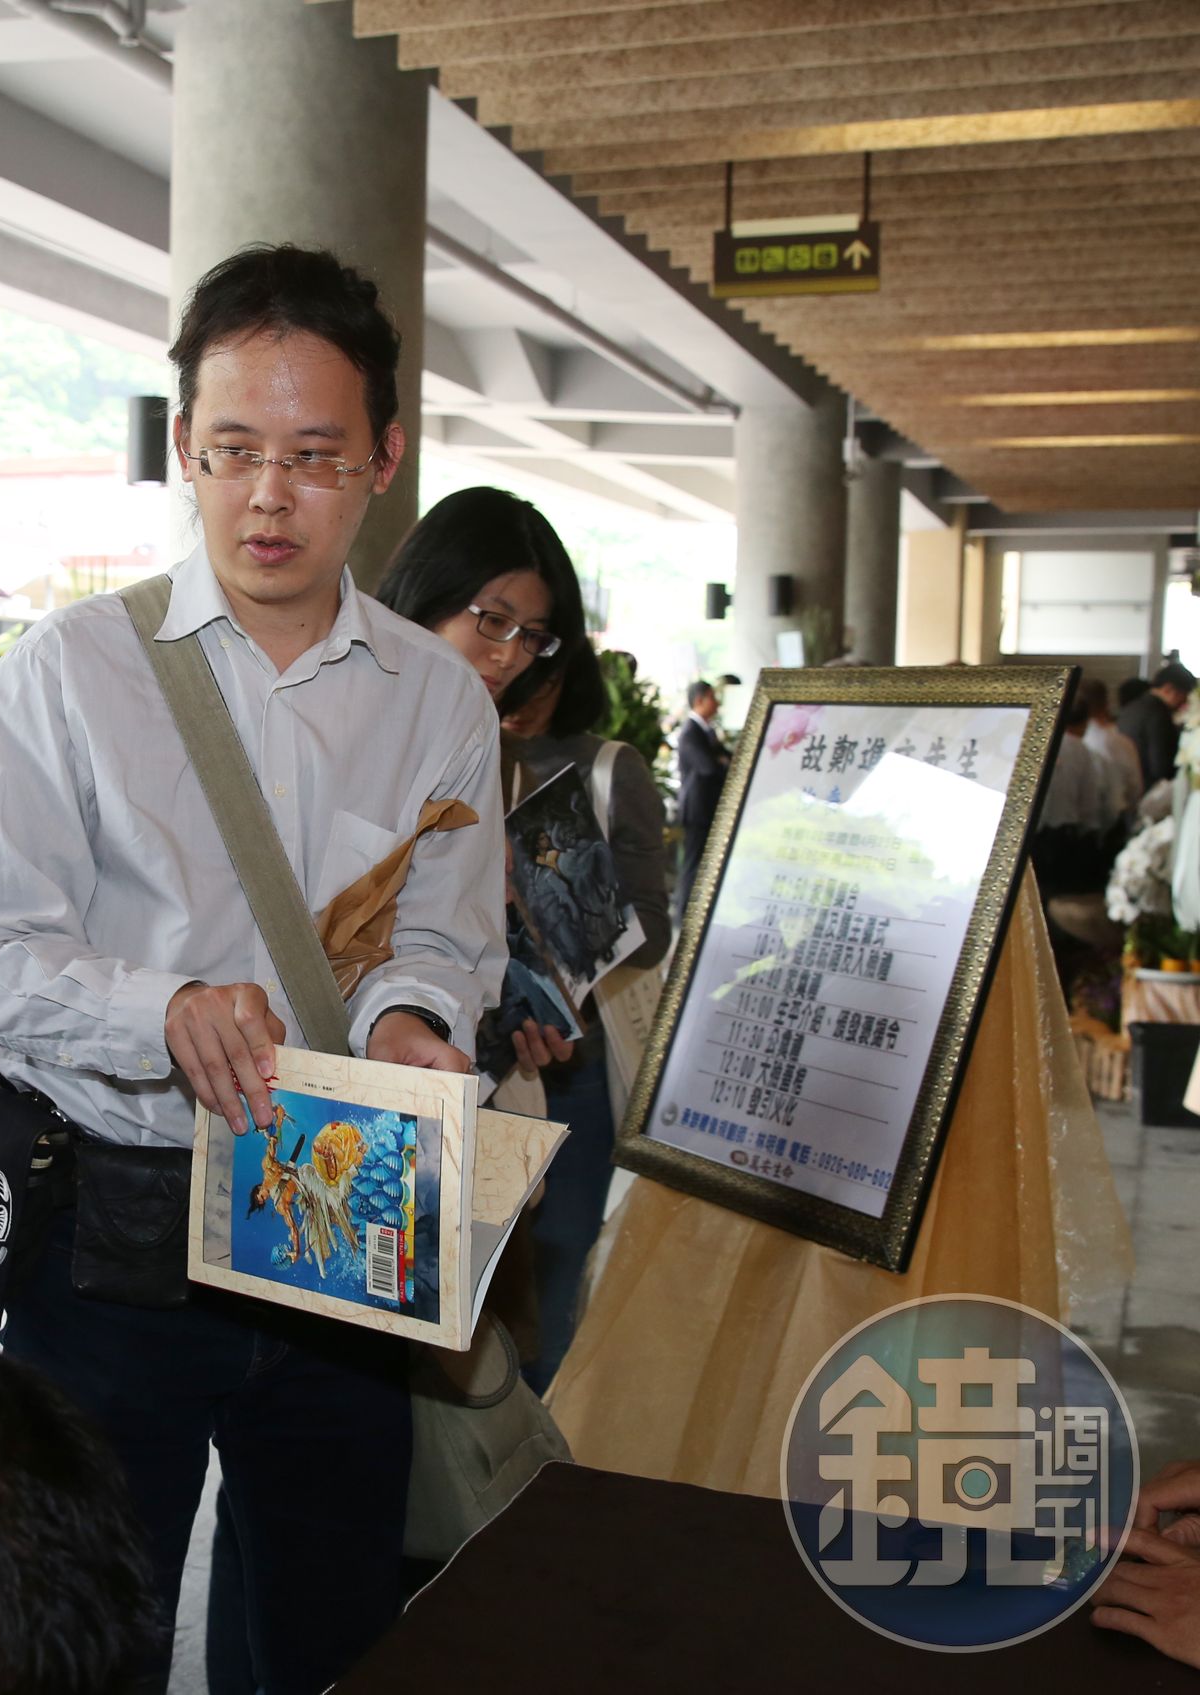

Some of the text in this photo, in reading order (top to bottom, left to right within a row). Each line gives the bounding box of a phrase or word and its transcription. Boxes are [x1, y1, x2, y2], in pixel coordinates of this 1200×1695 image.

[736, 992, 773, 1020] 11:00
[727, 1020, 765, 1050] 11:30
[718, 1049, 757, 1078] 12:00
[709, 1078, 747, 1109] 12:10
